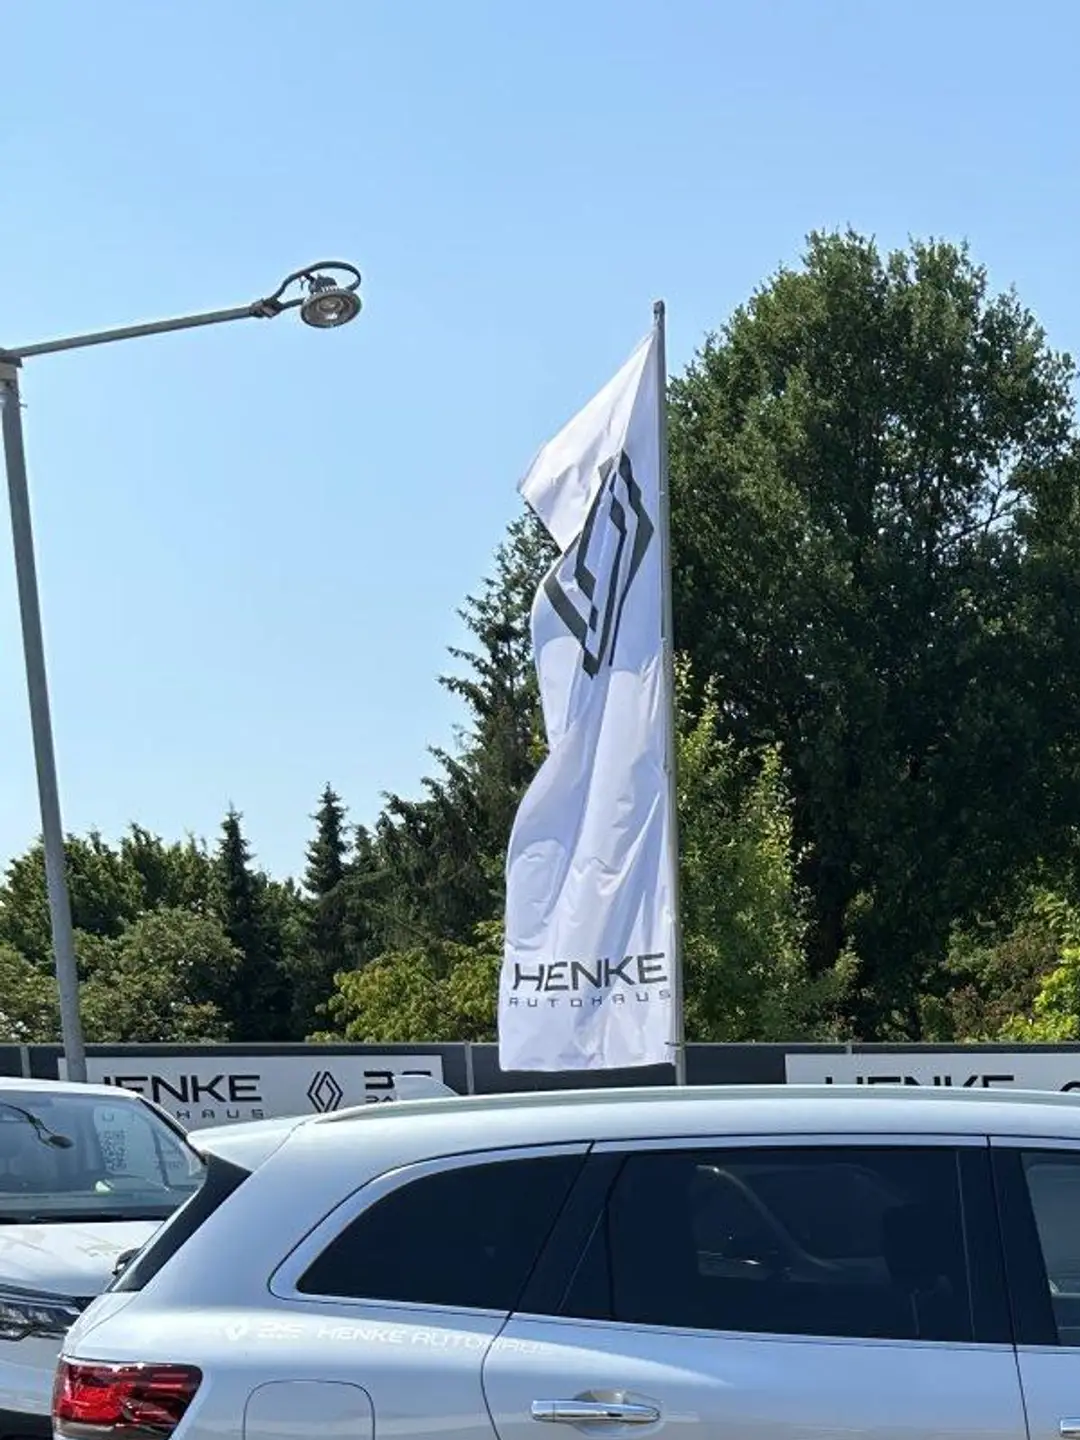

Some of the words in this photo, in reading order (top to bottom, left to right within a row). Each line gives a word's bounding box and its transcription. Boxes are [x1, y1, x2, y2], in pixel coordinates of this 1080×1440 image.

[512, 953, 668, 991] HENKE
[508, 989, 672, 1008] AUTOHAUS
[103, 1075, 263, 1103] ENKE
[317, 1325, 405, 1344] HENKE
